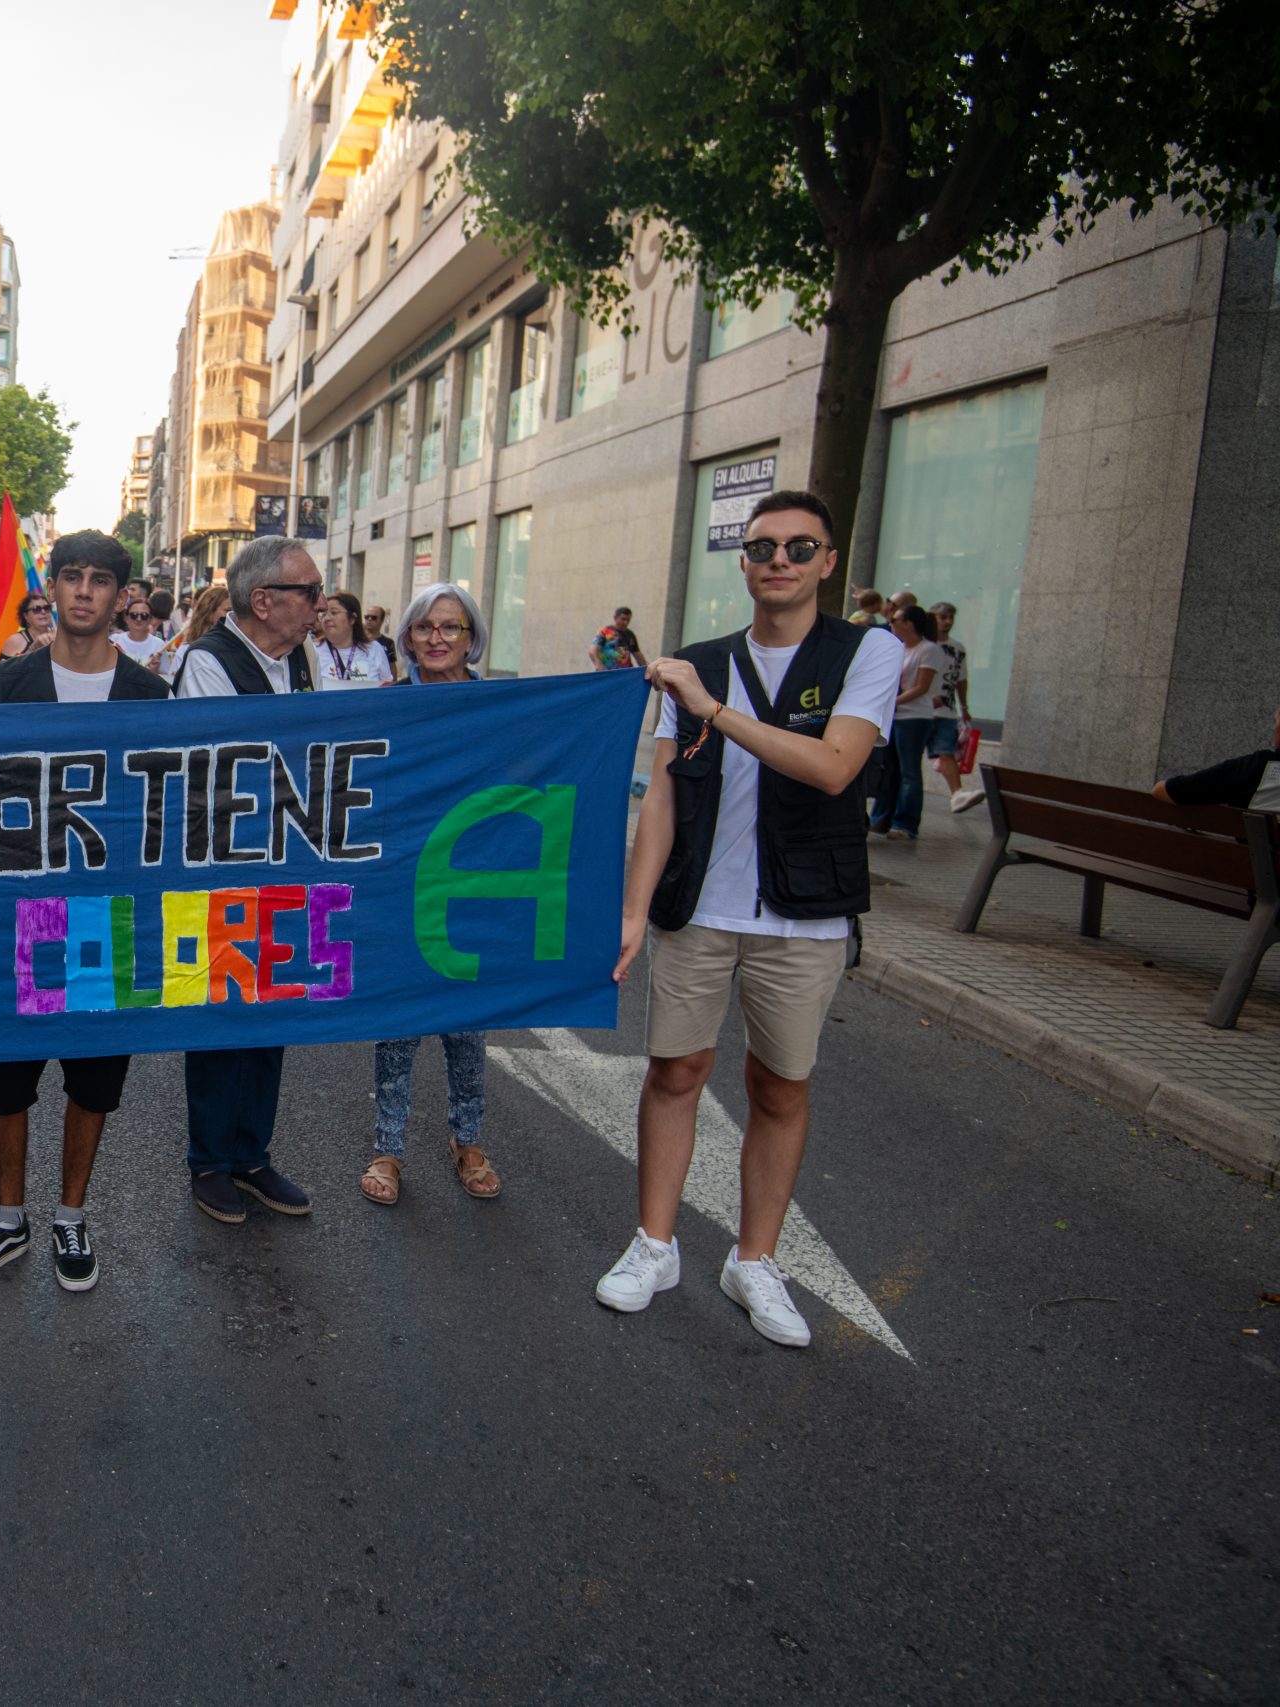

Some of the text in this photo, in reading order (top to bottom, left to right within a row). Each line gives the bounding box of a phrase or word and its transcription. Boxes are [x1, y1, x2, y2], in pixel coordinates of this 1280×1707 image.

[715, 458, 774, 487] EN ALQUILER
[122, 737, 390, 868] TIENE
[15, 881, 354, 1018] COLORES
